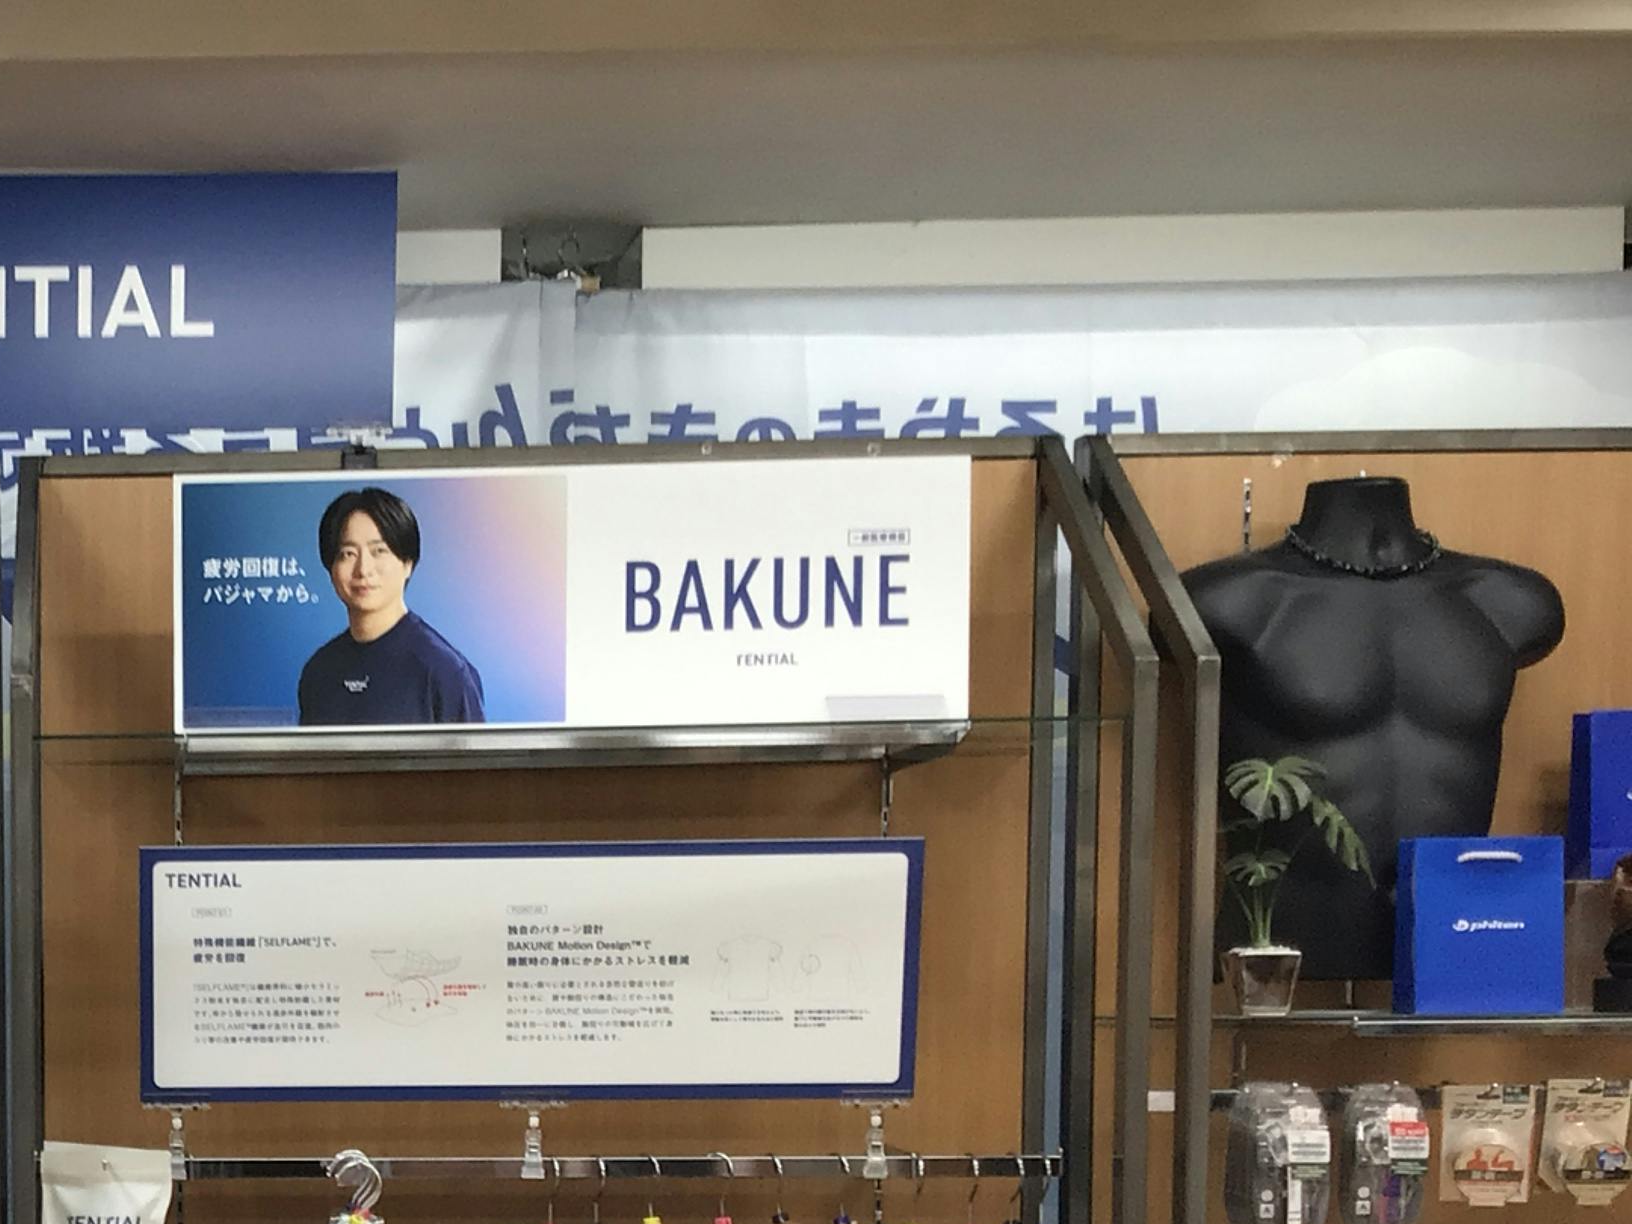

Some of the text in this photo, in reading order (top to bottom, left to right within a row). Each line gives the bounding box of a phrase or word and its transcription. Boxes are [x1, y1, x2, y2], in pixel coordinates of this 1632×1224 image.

[202, 557, 307, 579] 疲労回復は、
[202, 583, 319, 605] パジャマから。
[625, 553, 911, 633] BAKUNE
[736, 652, 799, 667] TENTIAL
[164, 872, 243, 889] TENTIAL
[507, 941, 555, 951] BAKUNE
[557, 941, 594, 951] Motion
